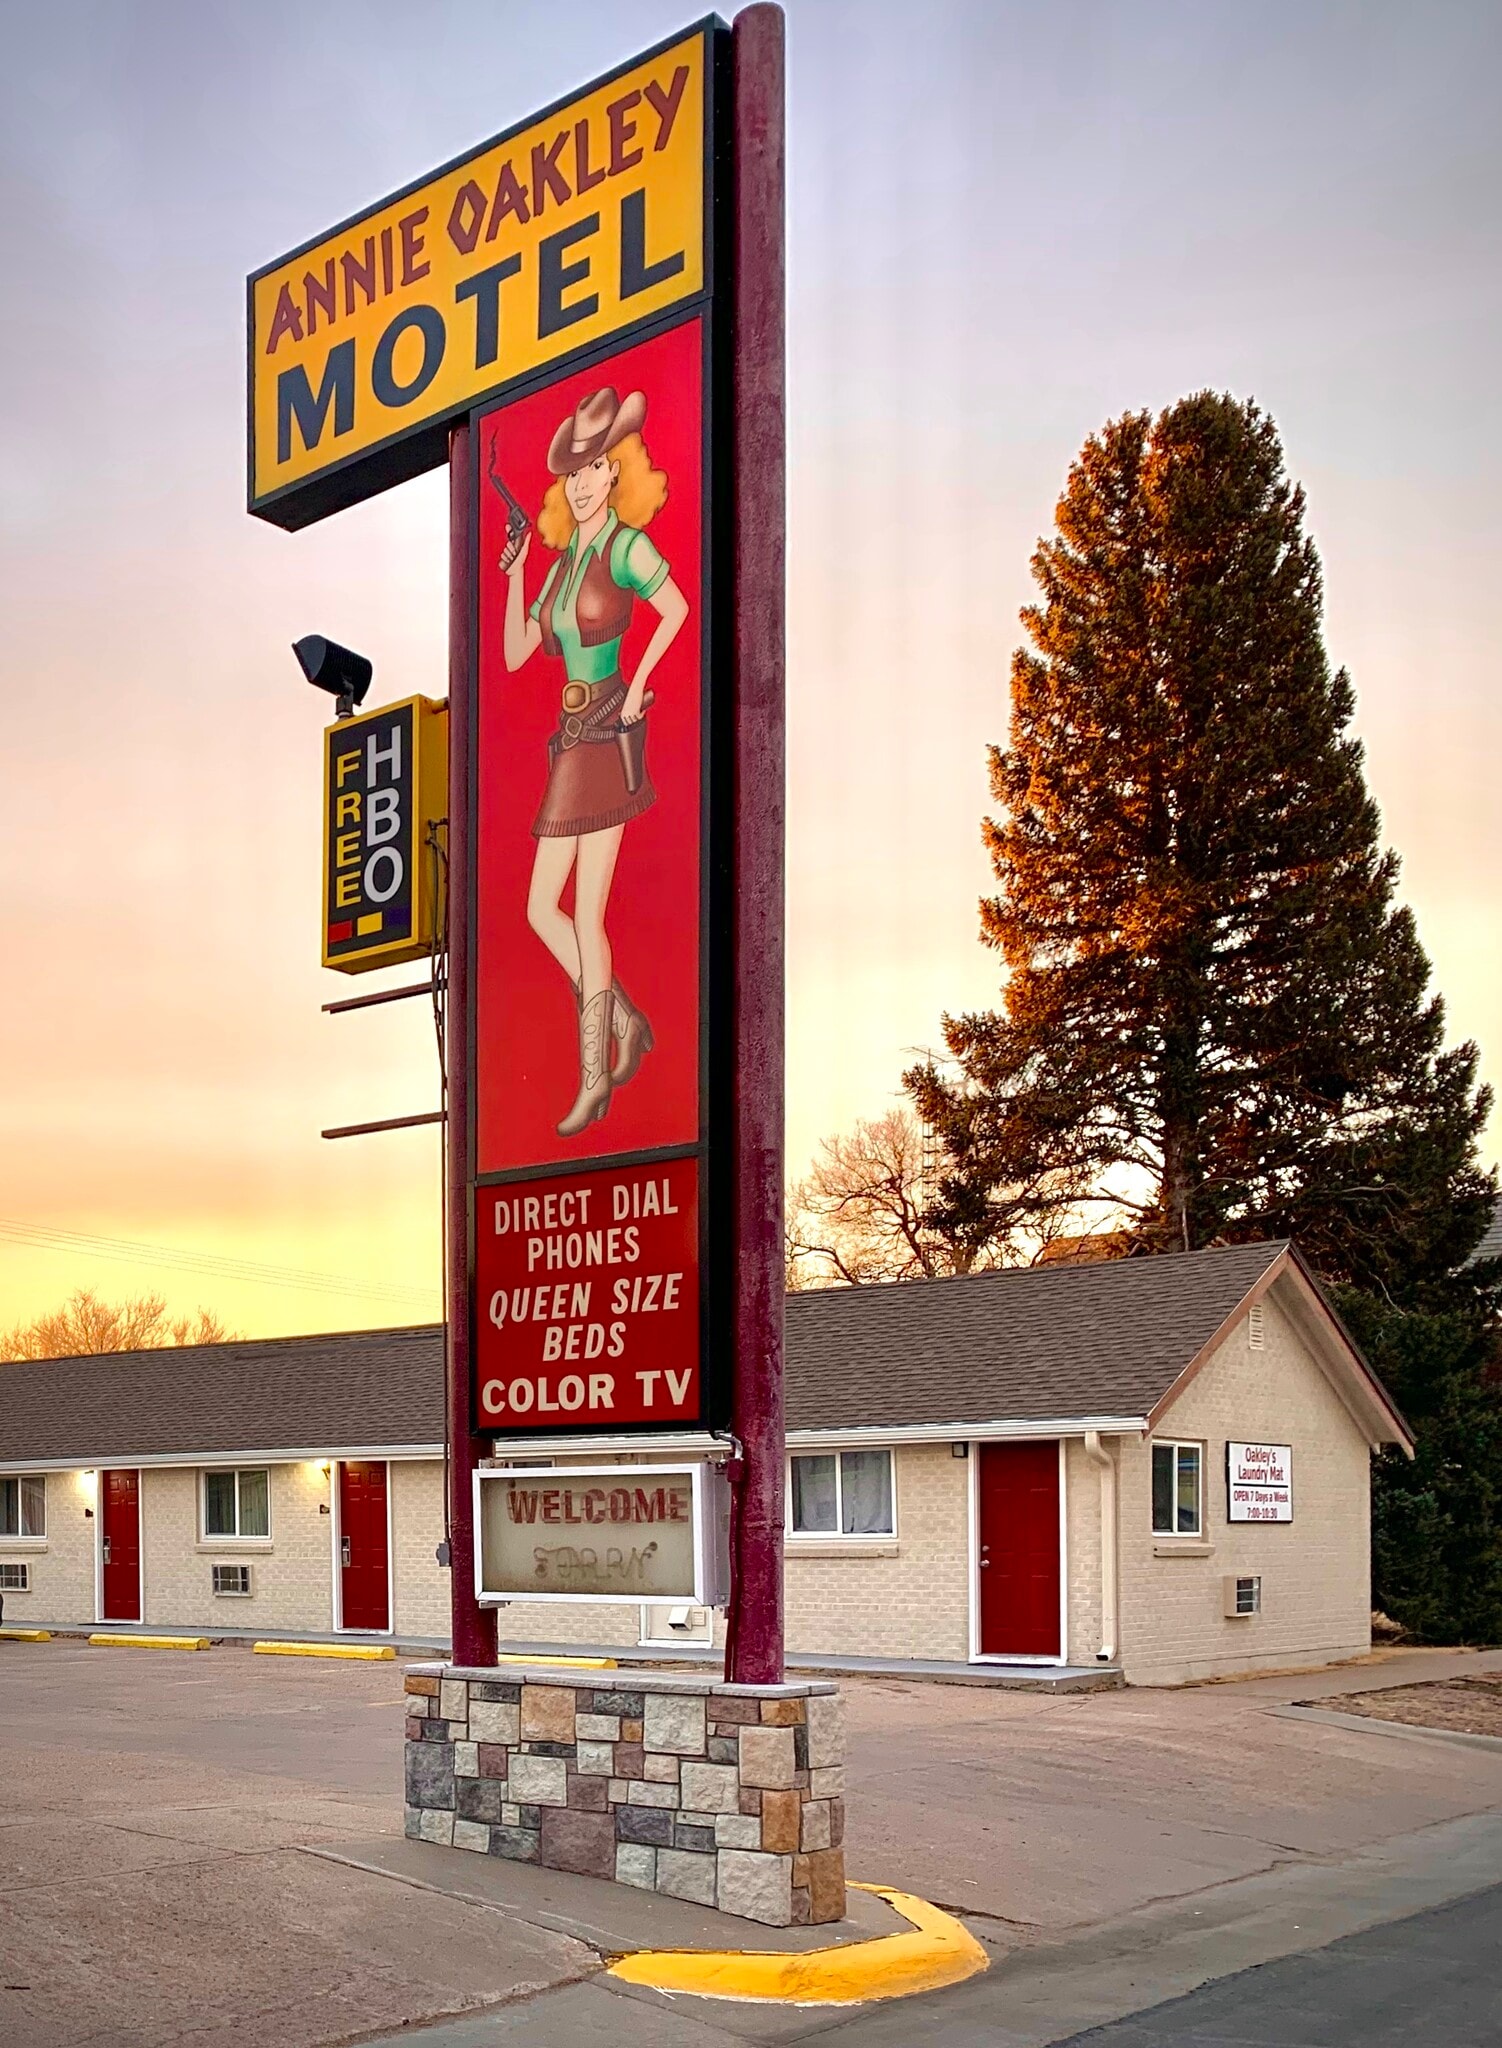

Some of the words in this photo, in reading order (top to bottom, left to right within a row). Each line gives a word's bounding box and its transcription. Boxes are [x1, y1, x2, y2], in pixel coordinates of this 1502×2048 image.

[266, 205, 430, 354] ANNIE
[446, 65, 690, 255] OAKLEY
[276, 187, 686, 465] MOTEL
[336, 749, 362, 908] FREE
[363, 725, 403, 903] HBO
[494, 1189, 592, 1235] DIRECT
[613, 1178, 679, 1221] DIAL
[528, 1226, 640, 1272] PHONES
[489, 1281, 592, 1330] QUEEN
[611, 1273, 683, 1314] SIZE
[542, 1321, 627, 1361] BEDS
[482, 1373, 615, 1414] COLOR
[635, 1368, 692, 1407] TV
[1238, 1464, 1268, 1484] Laundry
[1270, 1466, 1284, 1480] Mat
[1246, 1447, 1276, 1466] Oakley's
[508, 1487, 689, 1524] WELCOME
[1234, 1490, 1249, 1501] OPEN
[1250, 1491, 1254, 1501] 7
[1255, 1491, 1268, 1504] Days
[1274, 1491, 1288, 1502] Week
